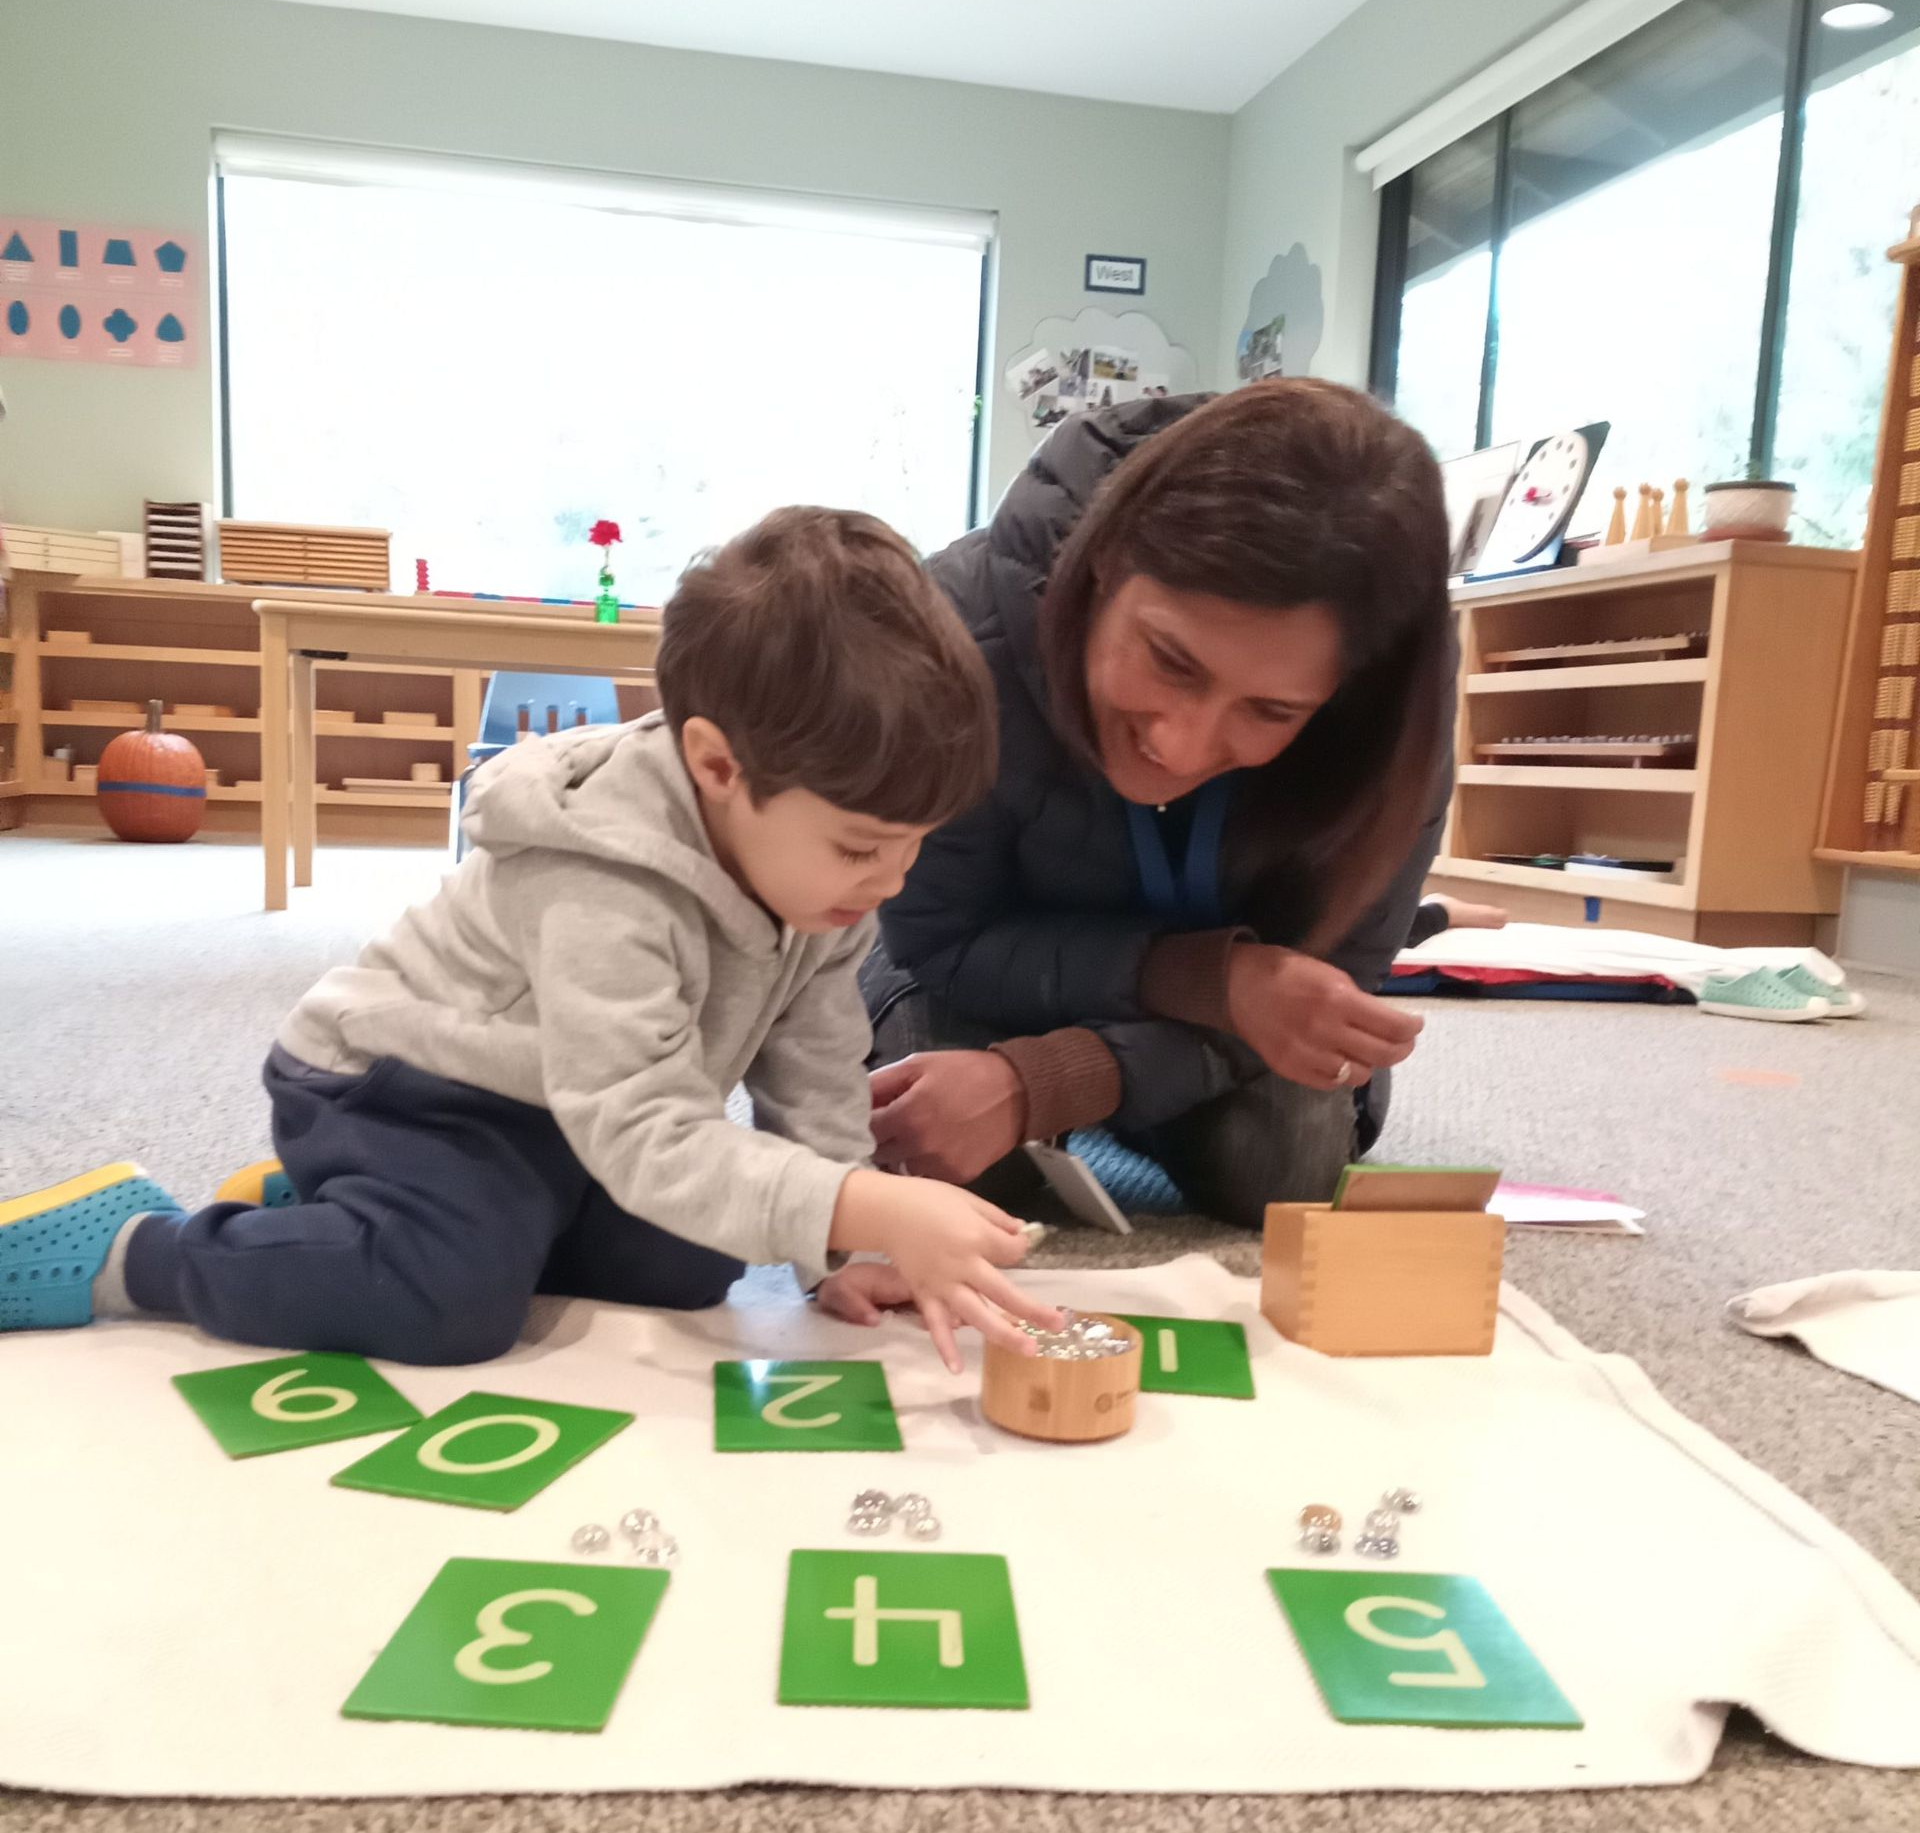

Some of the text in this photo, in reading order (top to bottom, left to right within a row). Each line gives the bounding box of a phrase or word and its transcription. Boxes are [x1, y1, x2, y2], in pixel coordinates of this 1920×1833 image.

[1096, 265, 1134, 282] West
[761, 1375, 843, 1429] 2
[453, 1588, 598, 1686] 3
[823, 1573, 964, 1669] 4
[1343, 1594, 1488, 1688] 5
